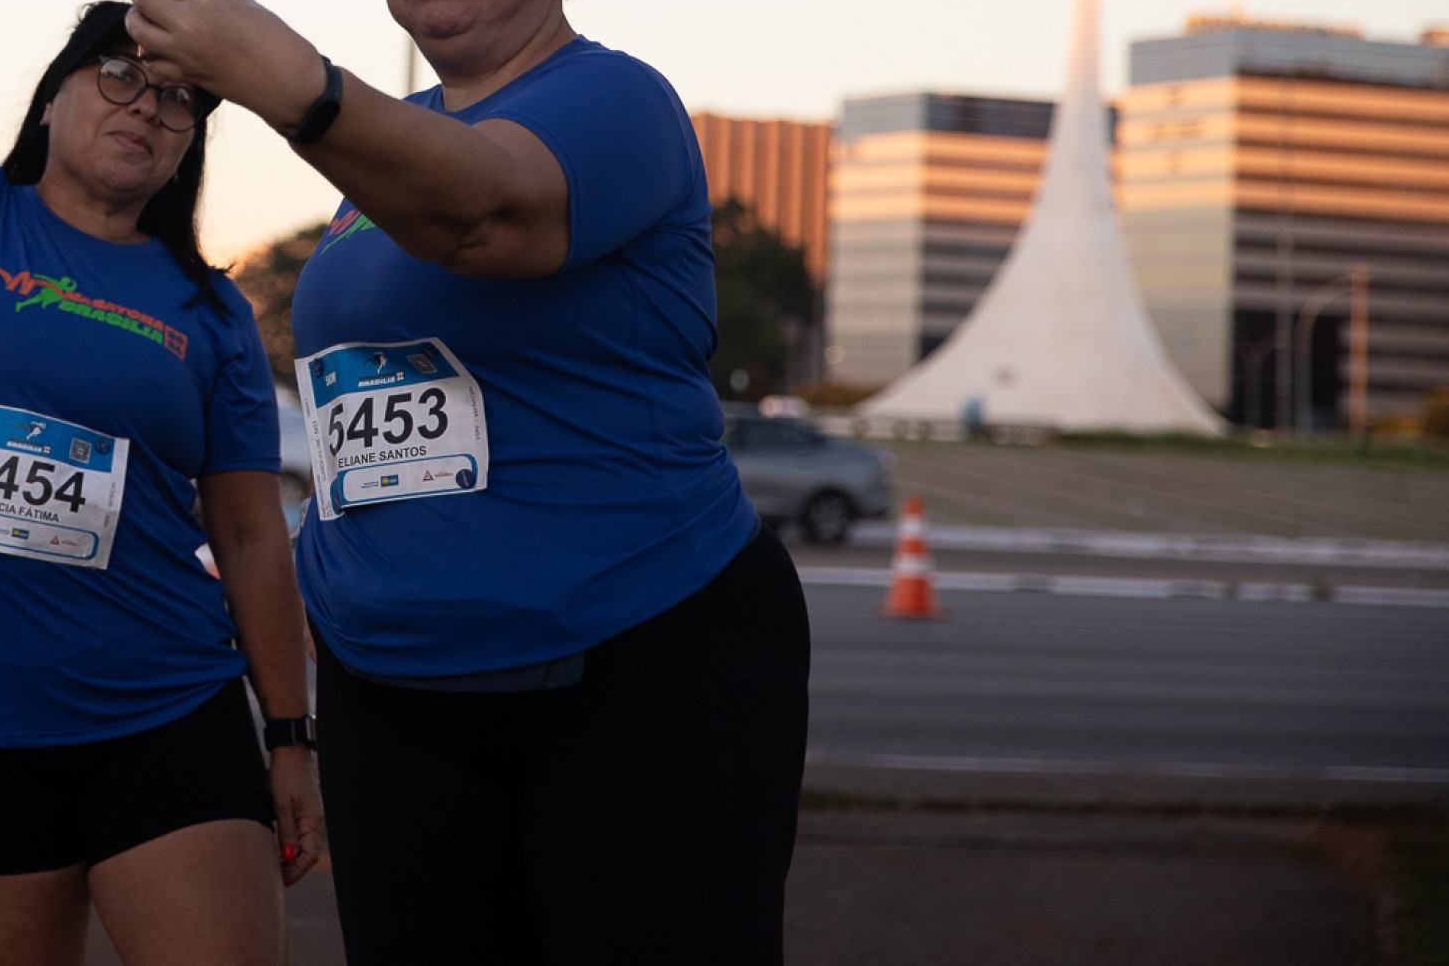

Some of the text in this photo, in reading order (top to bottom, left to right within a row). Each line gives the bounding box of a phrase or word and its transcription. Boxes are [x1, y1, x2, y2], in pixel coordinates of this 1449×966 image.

[328, 387, 448, 457] 5453
[338, 446, 427, 468] ELIANE SANTOS
